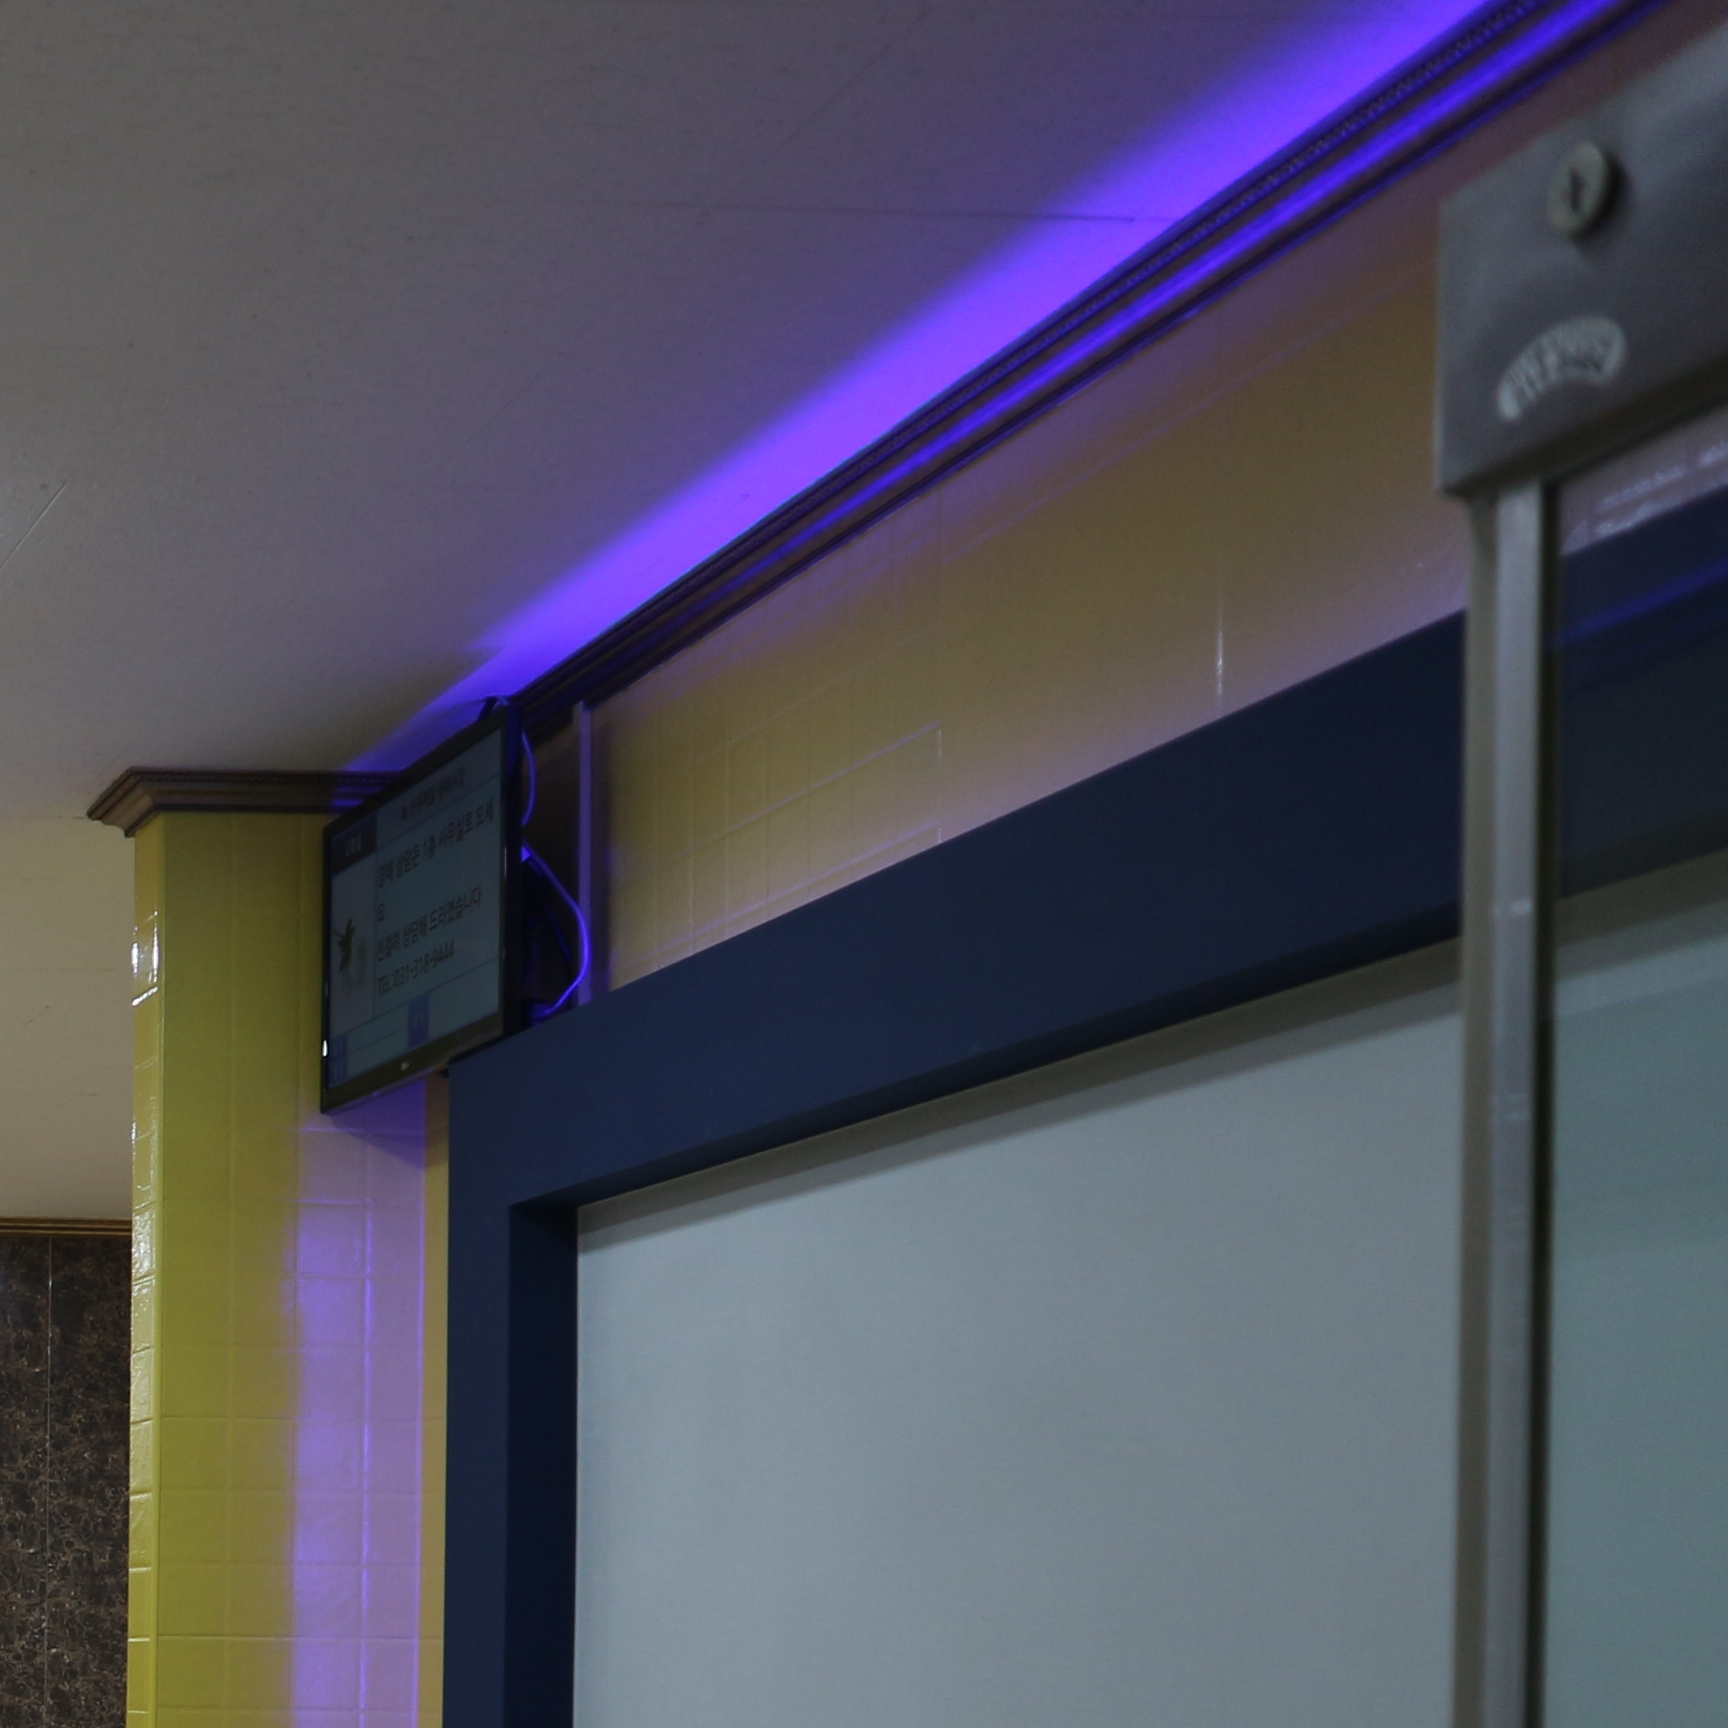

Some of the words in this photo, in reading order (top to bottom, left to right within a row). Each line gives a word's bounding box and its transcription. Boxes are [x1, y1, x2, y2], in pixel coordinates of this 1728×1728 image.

[395, 841, 420, 879] 상담은
[422, 832, 435, 862] 1층
[439, 808, 473, 852] 사무실로
[475, 796, 493, 830] 오세
[377, 901, 384, 923] 요
[402, 913, 427, 949] 상담해
[429, 882, 481, 935] 드리겠습니다
